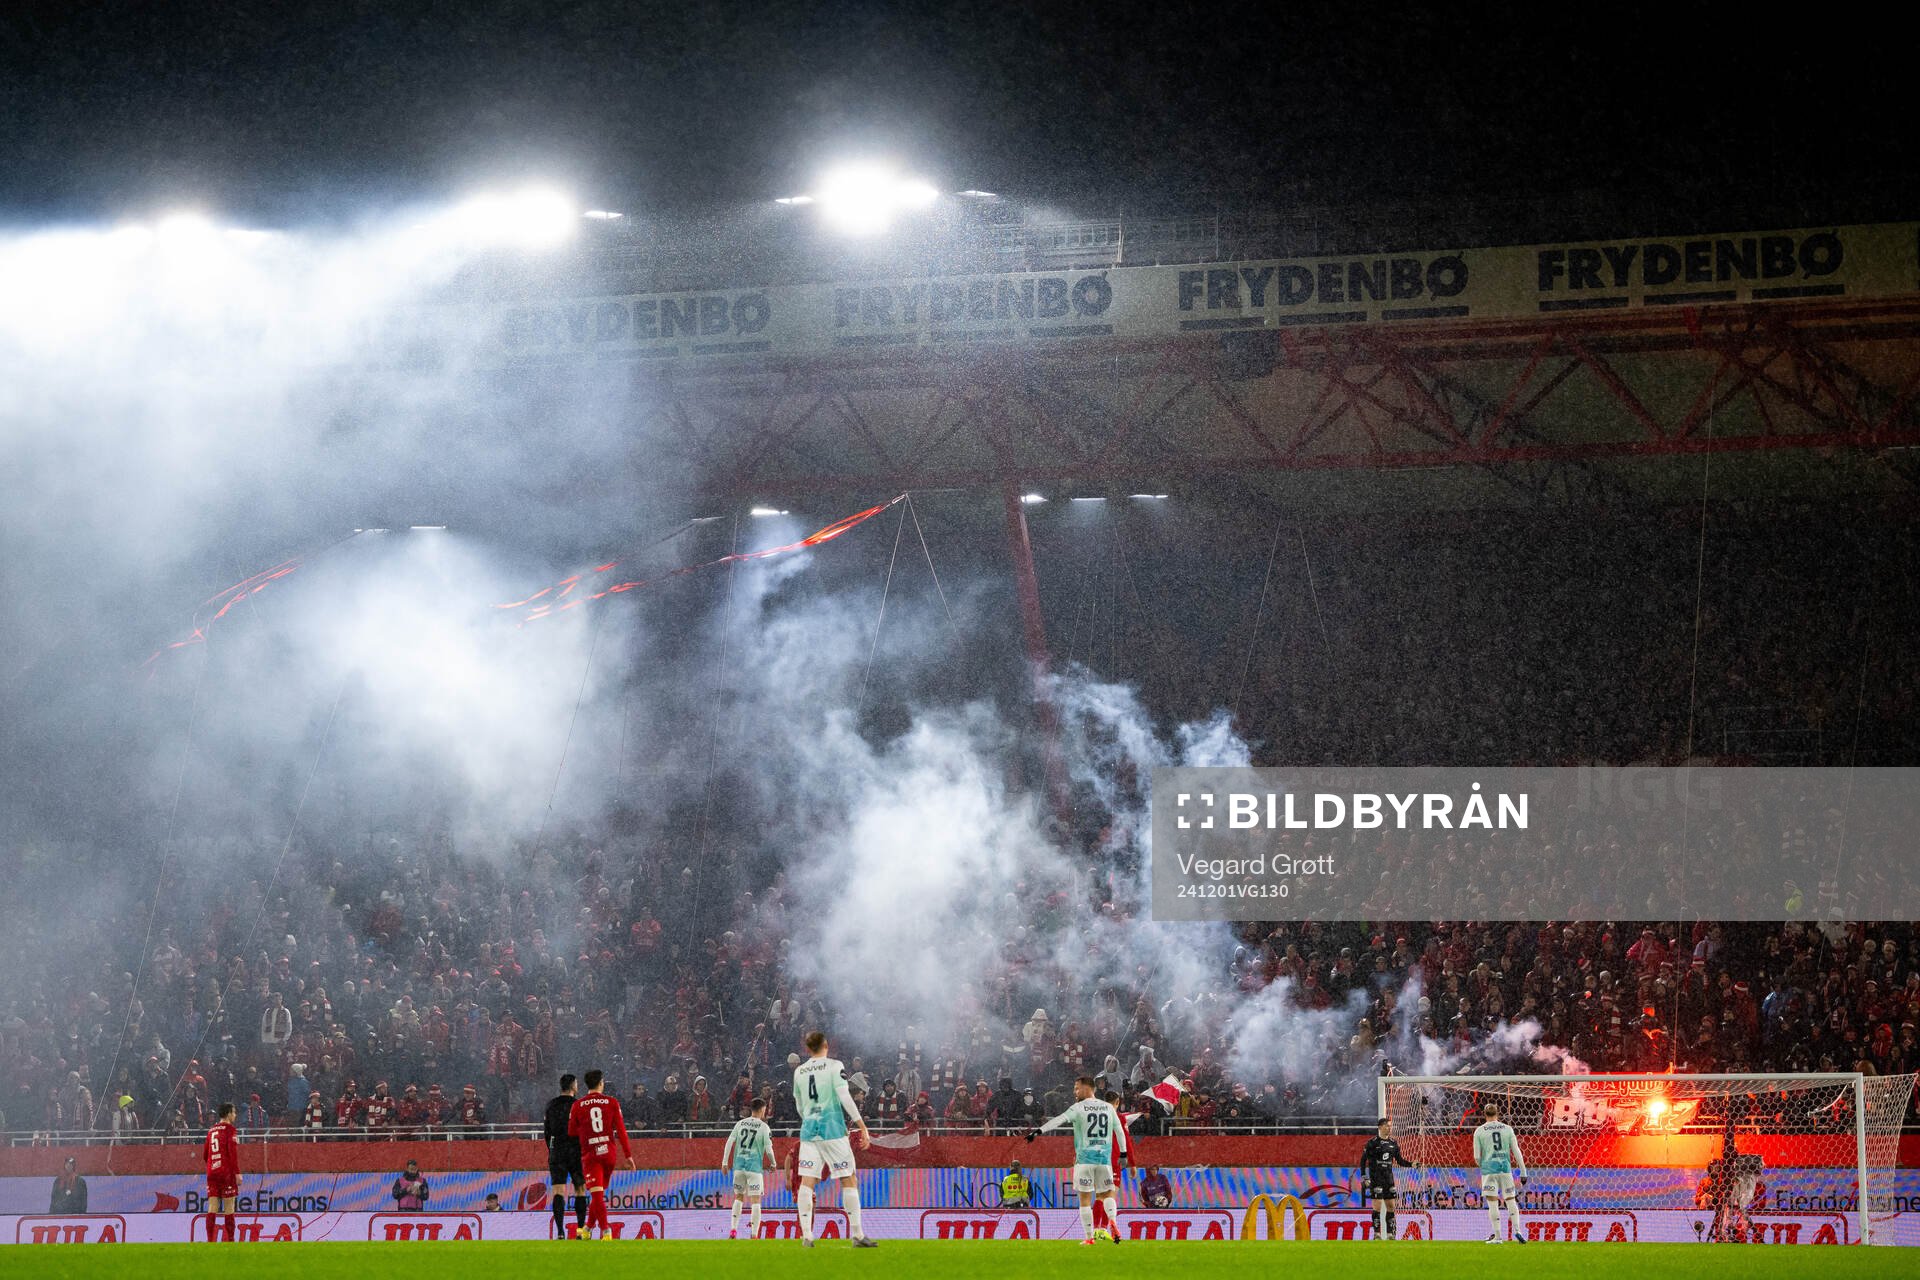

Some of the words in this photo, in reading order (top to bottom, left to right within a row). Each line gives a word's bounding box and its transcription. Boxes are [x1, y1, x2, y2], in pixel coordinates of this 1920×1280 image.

[1538, 231, 1844, 291] FRYDENBØ
[1179, 252, 1468, 311] FRYDENBØ
[834, 271, 1113, 327] FRYDENBØ
[808, 1075, 819, 1103] 4
[580, 1098, 609, 1107] FOTMOB
[590, 1107, 604, 1133] 8
[1087, 1113, 1108, 1137] 29
[211, 1131, 220, 1152] 5
[740, 1128, 757, 1150] 27
[1492, 1132, 1503, 1151] 9
[185, 1191, 252, 1212] Bre
[256, 1190, 328, 1212] Finans
[953, 1182, 1078, 1208] NONE
